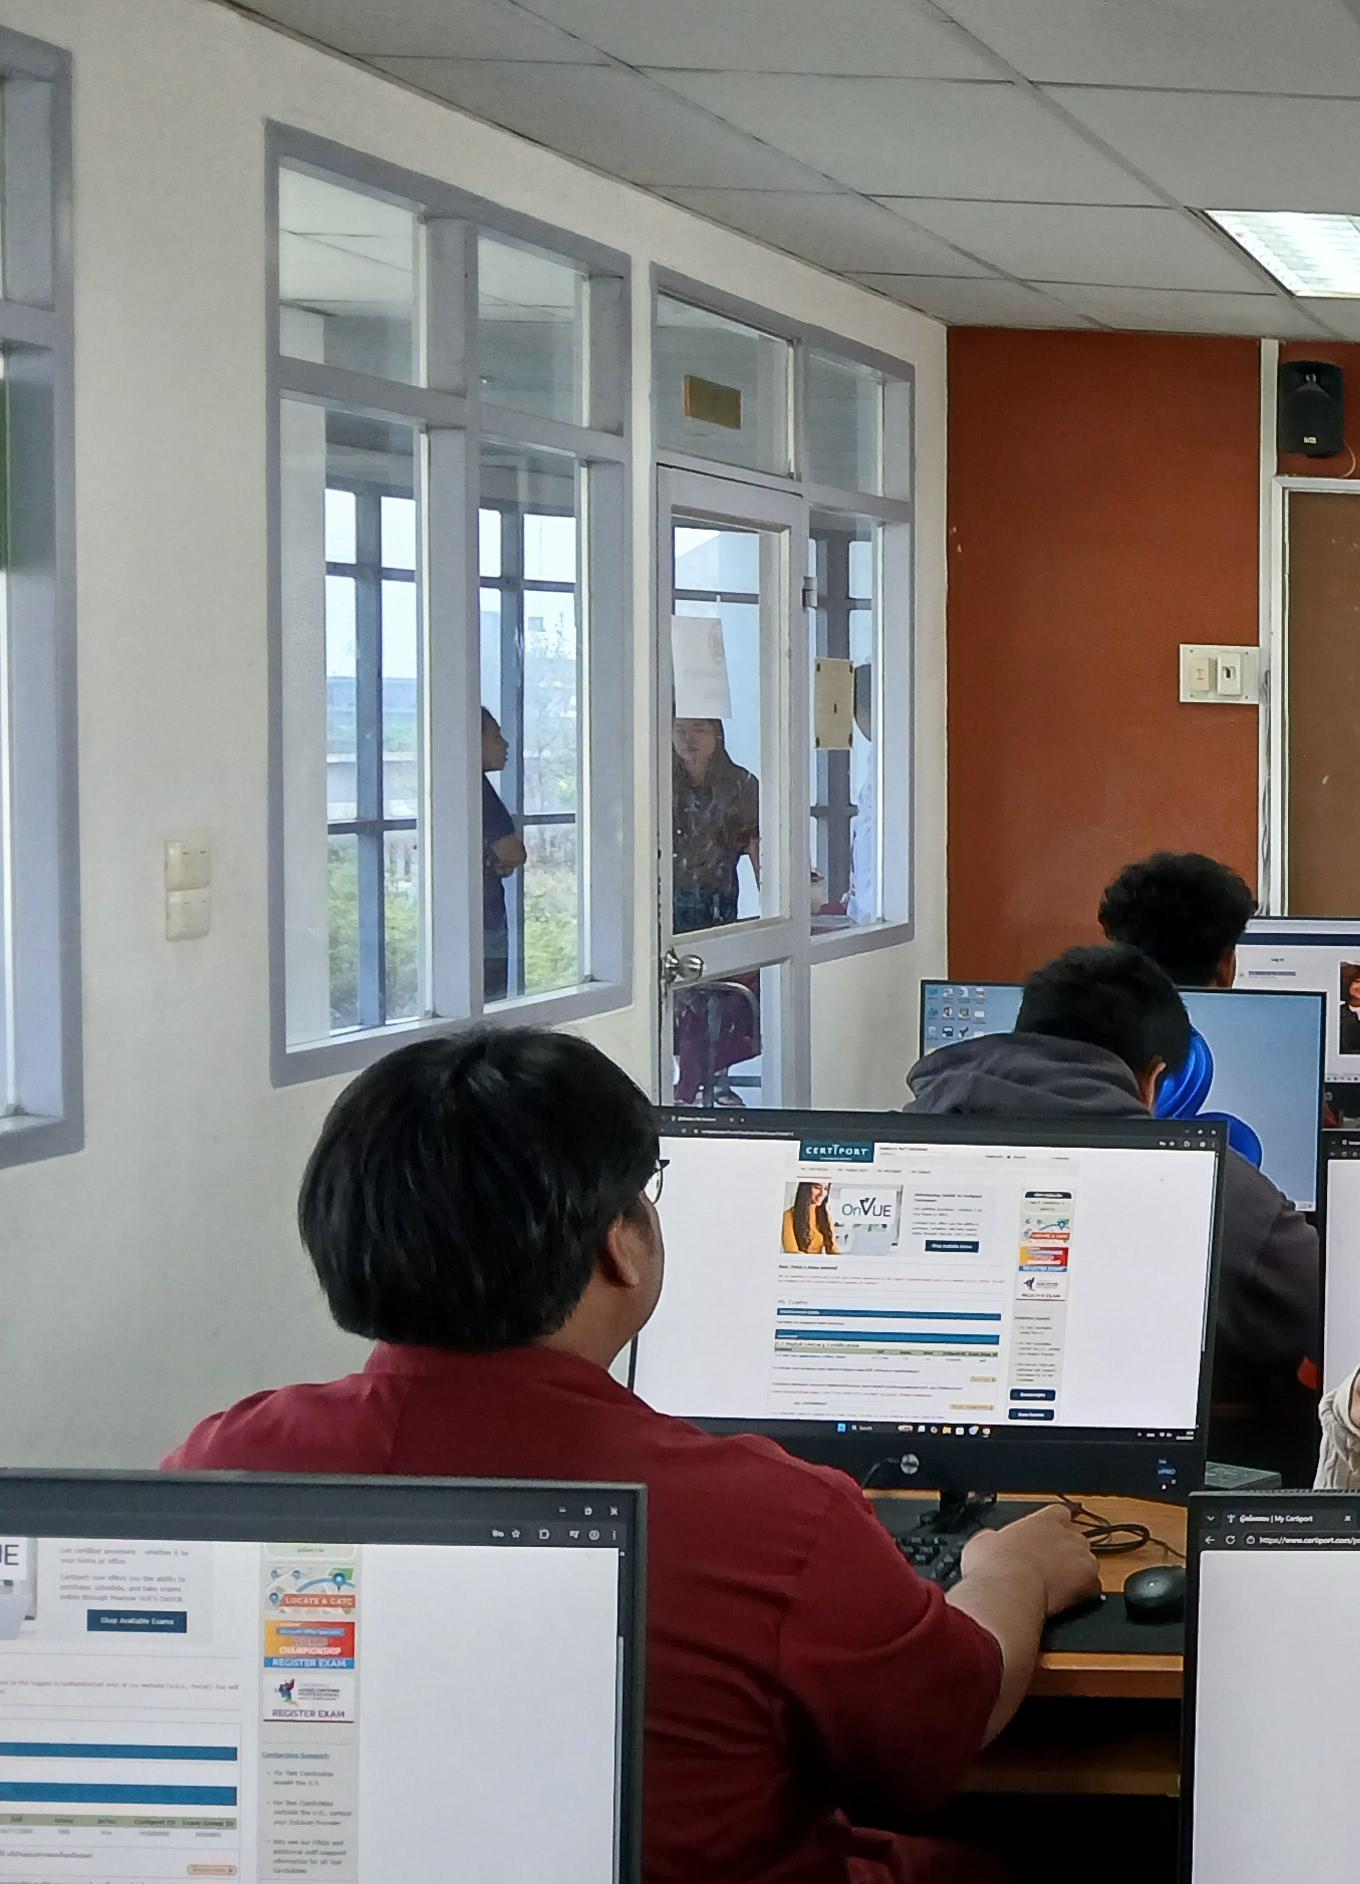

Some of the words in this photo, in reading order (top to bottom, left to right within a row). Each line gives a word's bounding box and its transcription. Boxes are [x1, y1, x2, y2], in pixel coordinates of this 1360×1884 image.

[805, 1143, 870, 1156] CERTIPORT
[841, 1197, 892, 1218] OnVUE
[272, 1709, 315, 1718] REGISTER
[318, 1710, 345, 1718] EXAM
